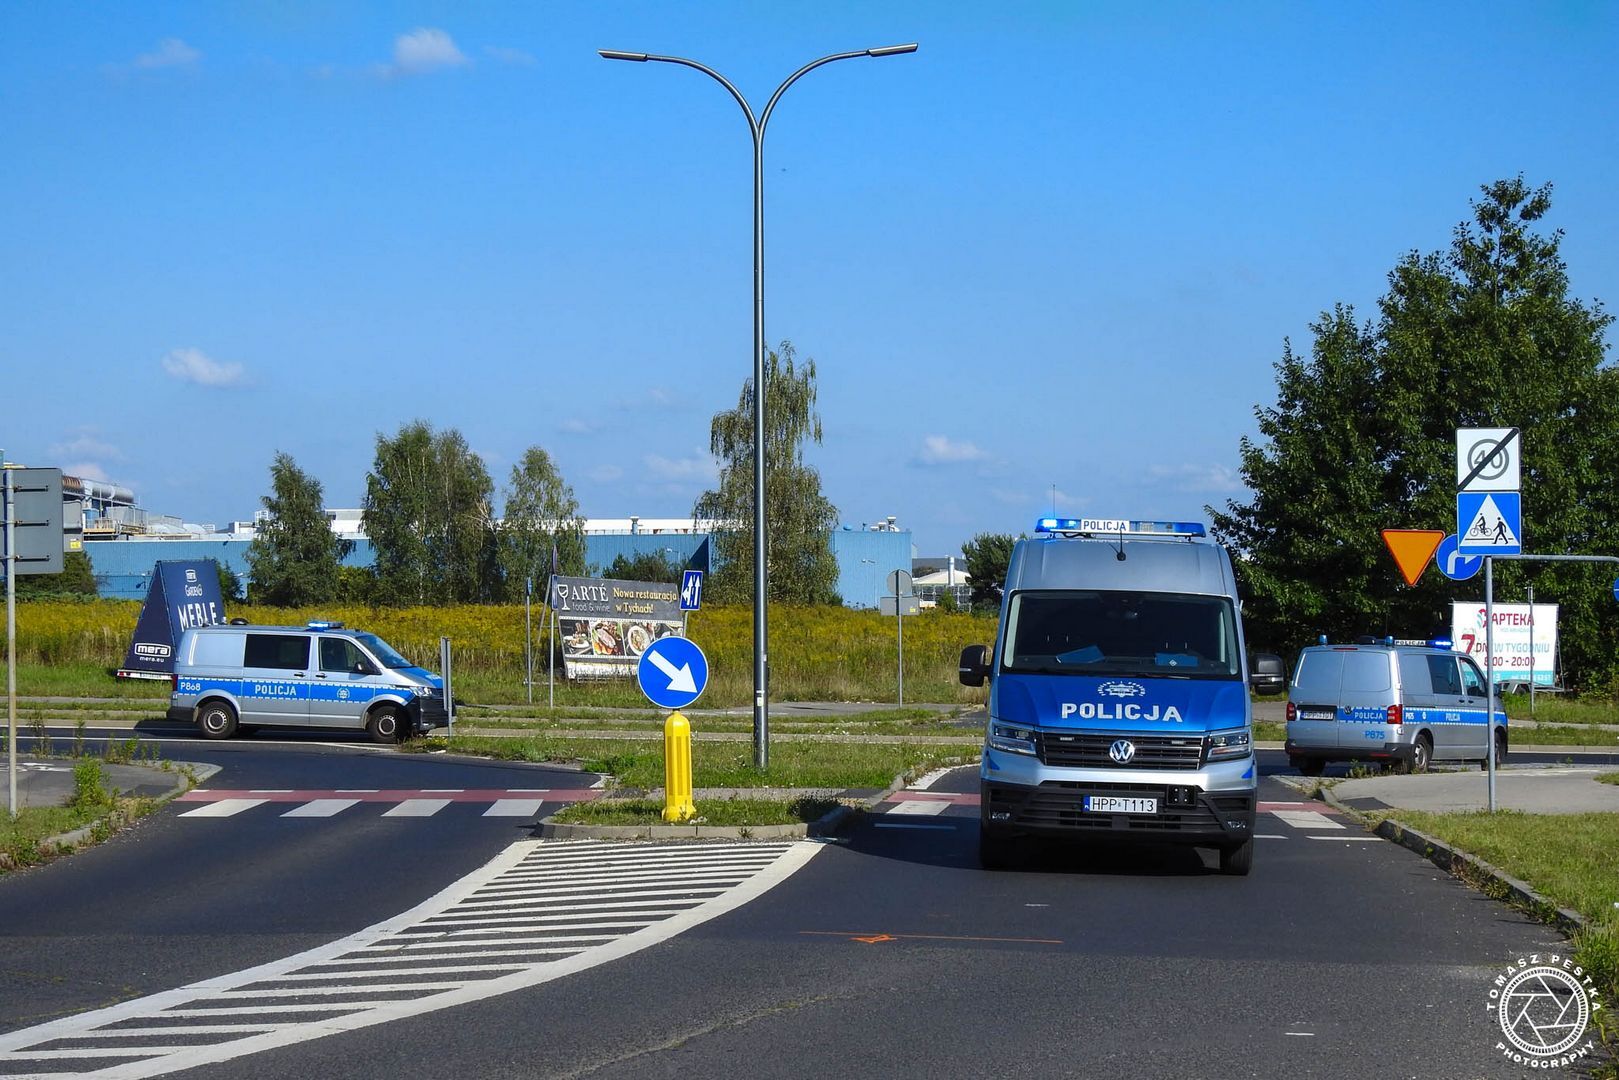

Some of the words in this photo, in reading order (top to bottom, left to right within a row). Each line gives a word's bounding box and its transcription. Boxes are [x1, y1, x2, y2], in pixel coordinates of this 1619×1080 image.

[1083, 520, 1126, 531] POLICJA
[571, 583, 608, 602] ARTÉ
[613, 587, 634, 598] Nowa
[636, 590, 677, 603] restauracja
[623, 602, 654, 615] Tychach!
[178, 602, 218, 633] MEBLE
[1491, 613, 1534, 626] APTEKA
[137, 645, 168, 655] mera
[180, 682, 201, 691] P868
[255, 684, 297, 696] POLICJA
[1061, 703, 1183, 723] POLICJA
[1354, 711, 1384, 720] POLICJA
[1364, 730, 1385, 739] P875
[1092, 797, 1117, 811] HPP
[1123, 798, 1154, 812] T113
